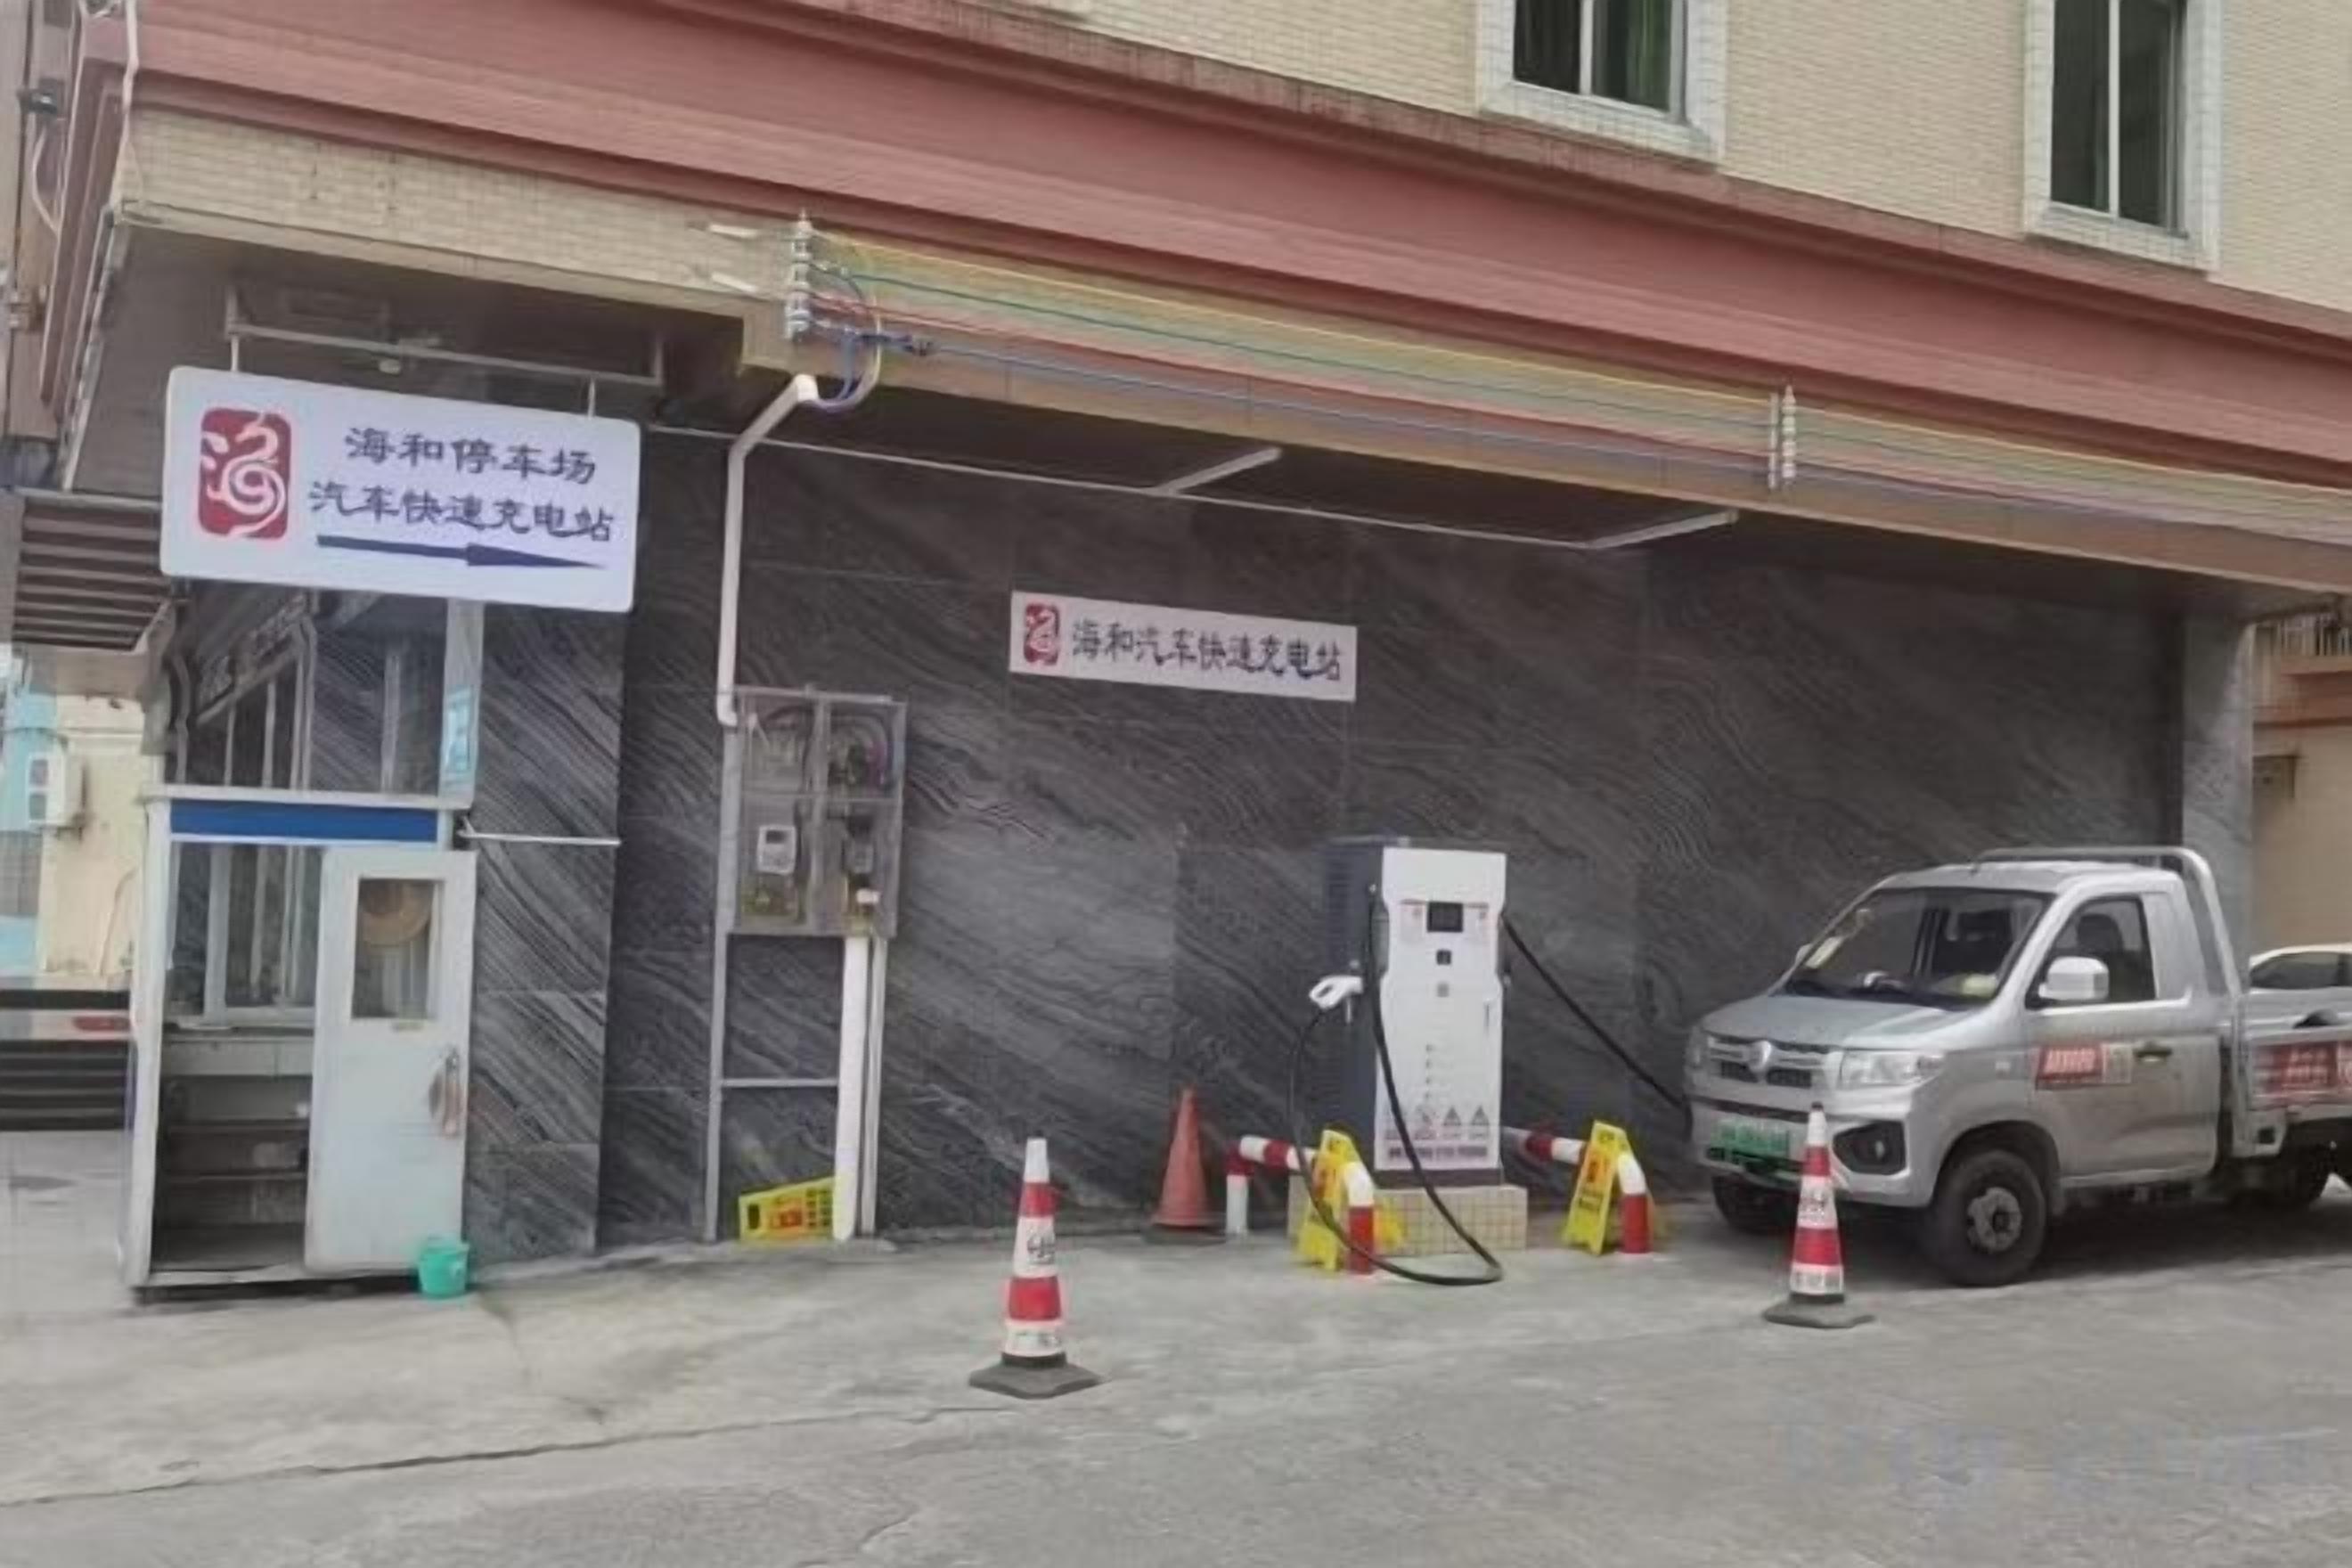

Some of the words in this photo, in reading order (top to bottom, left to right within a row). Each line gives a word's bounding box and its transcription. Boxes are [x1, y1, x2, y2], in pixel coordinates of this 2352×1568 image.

[345, 427, 595, 484] 海和停车场
[309, 480, 614, 542] 汽车快速充电站
[1072, 618, 1340, 681] 海和汽车快速充电站
